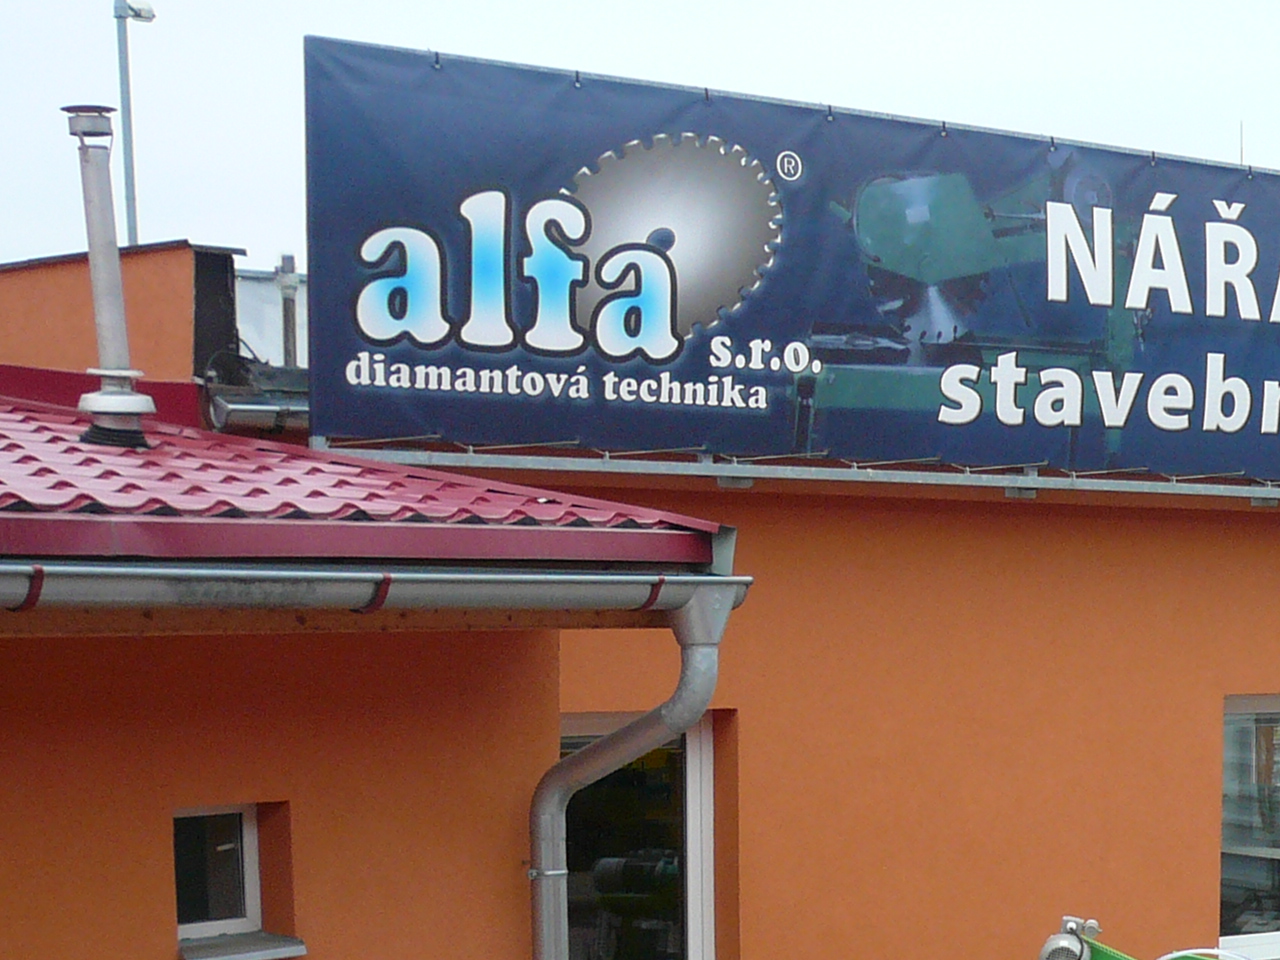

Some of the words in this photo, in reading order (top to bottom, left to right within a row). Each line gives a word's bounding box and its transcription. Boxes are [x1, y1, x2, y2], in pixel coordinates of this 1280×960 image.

[354, 190, 680, 361] alfa
[709, 335, 823, 374] s.r.o.
[345, 352, 590, 400] diamantová
[602, 373, 768, 410] technika
